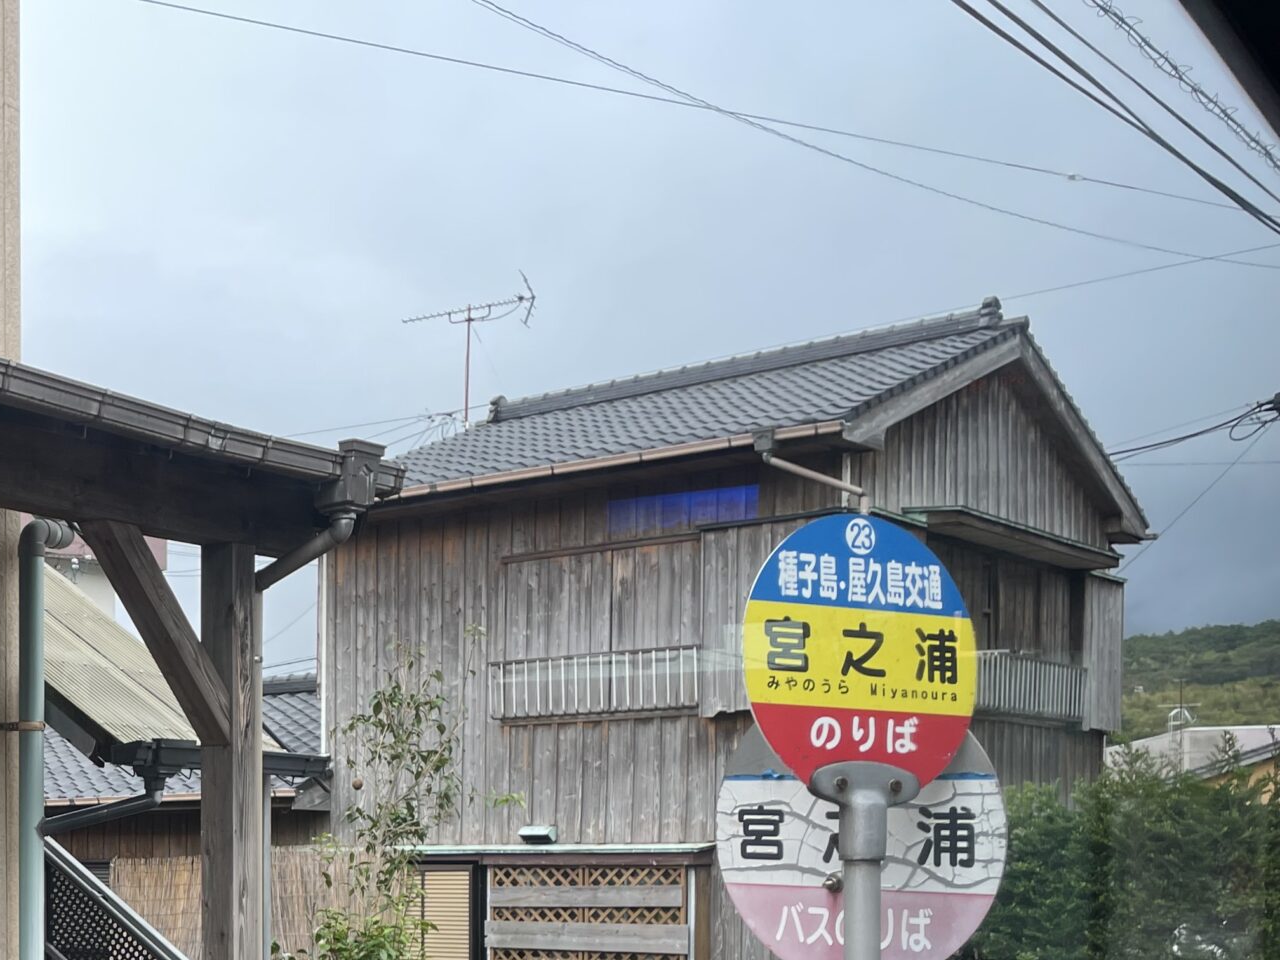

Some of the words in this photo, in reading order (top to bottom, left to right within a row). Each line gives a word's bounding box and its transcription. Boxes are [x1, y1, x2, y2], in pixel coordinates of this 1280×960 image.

[849, 522, 873, 550] 23
[777, 549, 943, 611] 種子島・屋久島交通
[763, 616, 959, 686] 宮之浦
[766, 675, 849, 696] みやのうら
[870, 683, 958, 703] Miyanoura
[810, 715, 918, 755] のりば
